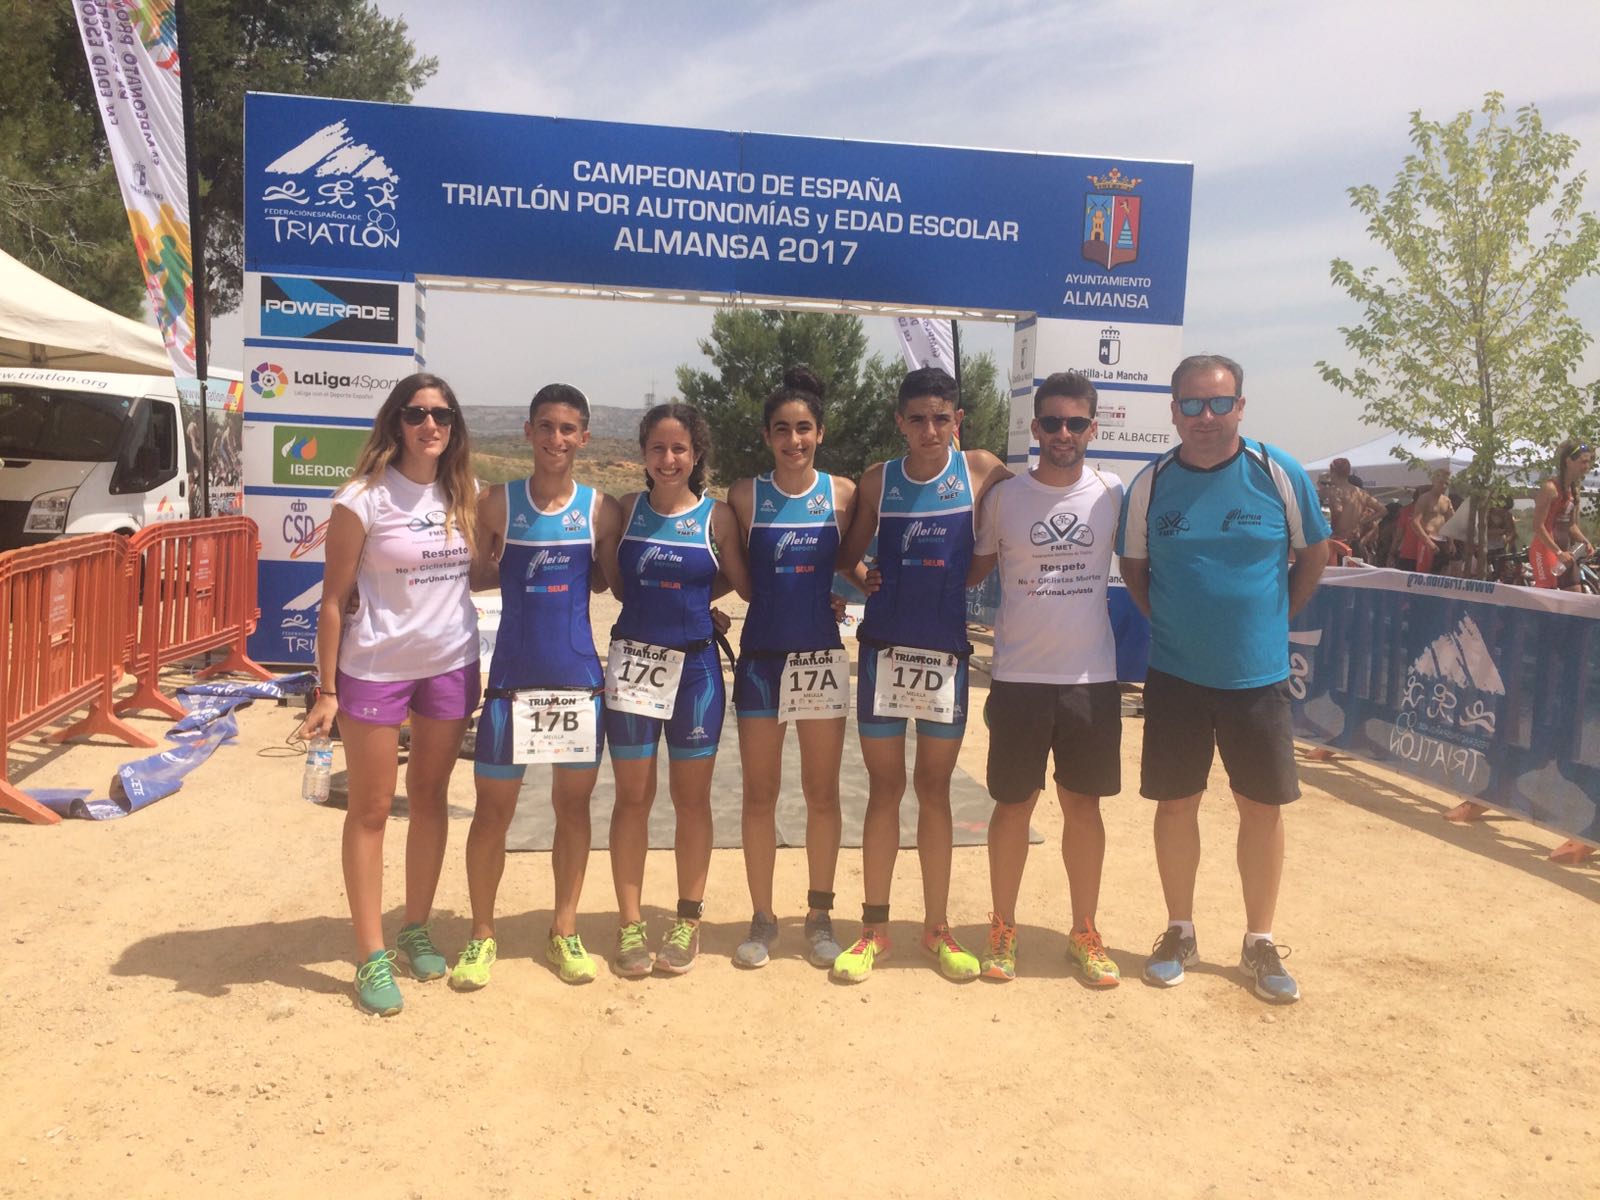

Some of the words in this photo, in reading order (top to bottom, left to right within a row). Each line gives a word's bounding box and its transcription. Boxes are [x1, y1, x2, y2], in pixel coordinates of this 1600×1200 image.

[573, 160, 755, 194] CAMPEONATO
[762, 174, 794, 197] DE
[800, 176, 902, 204] ESPAÑA
[442, 182, 570, 211] TRIATLÓN
[577, 191, 630, 215] POR
[636, 196, 810, 228] AUTONOMÍAS
[816, 213, 829, 233] y
[835, 209, 903, 233] EDAD
[909, 214, 1019, 241] ESCOLAR
[265, 216, 400, 248] TRIATLÓN
[614, 226, 770, 260] ALMANSA
[778, 236, 858, 266] 2017
[1065, 274, 1151, 288] AYUNTAMIENTO
[1063, 290, 1150, 309] ALMANSA
[0, 371, 107, 389] w.triatlon.org
[1117, 371, 1148, 382] Mancha
[1101, 431, 1115, 440] DE
[1118, 432, 1170, 443] ALBACETE
[283, 514, 315, 544] CSD
[422, 547, 469, 559] Respeto
[1040, 563, 1086, 573] Respeto
[1038, 576, 1074, 584] Ciclistas
[623, 646, 667, 661] TRIATLON
[789, 656, 833, 667] TRIATLON
[618, 660, 667, 688] 17C
[790, 669, 838, 692] 17A
[892, 666, 943, 691] 17D
[530, 711, 579, 732] 17B
